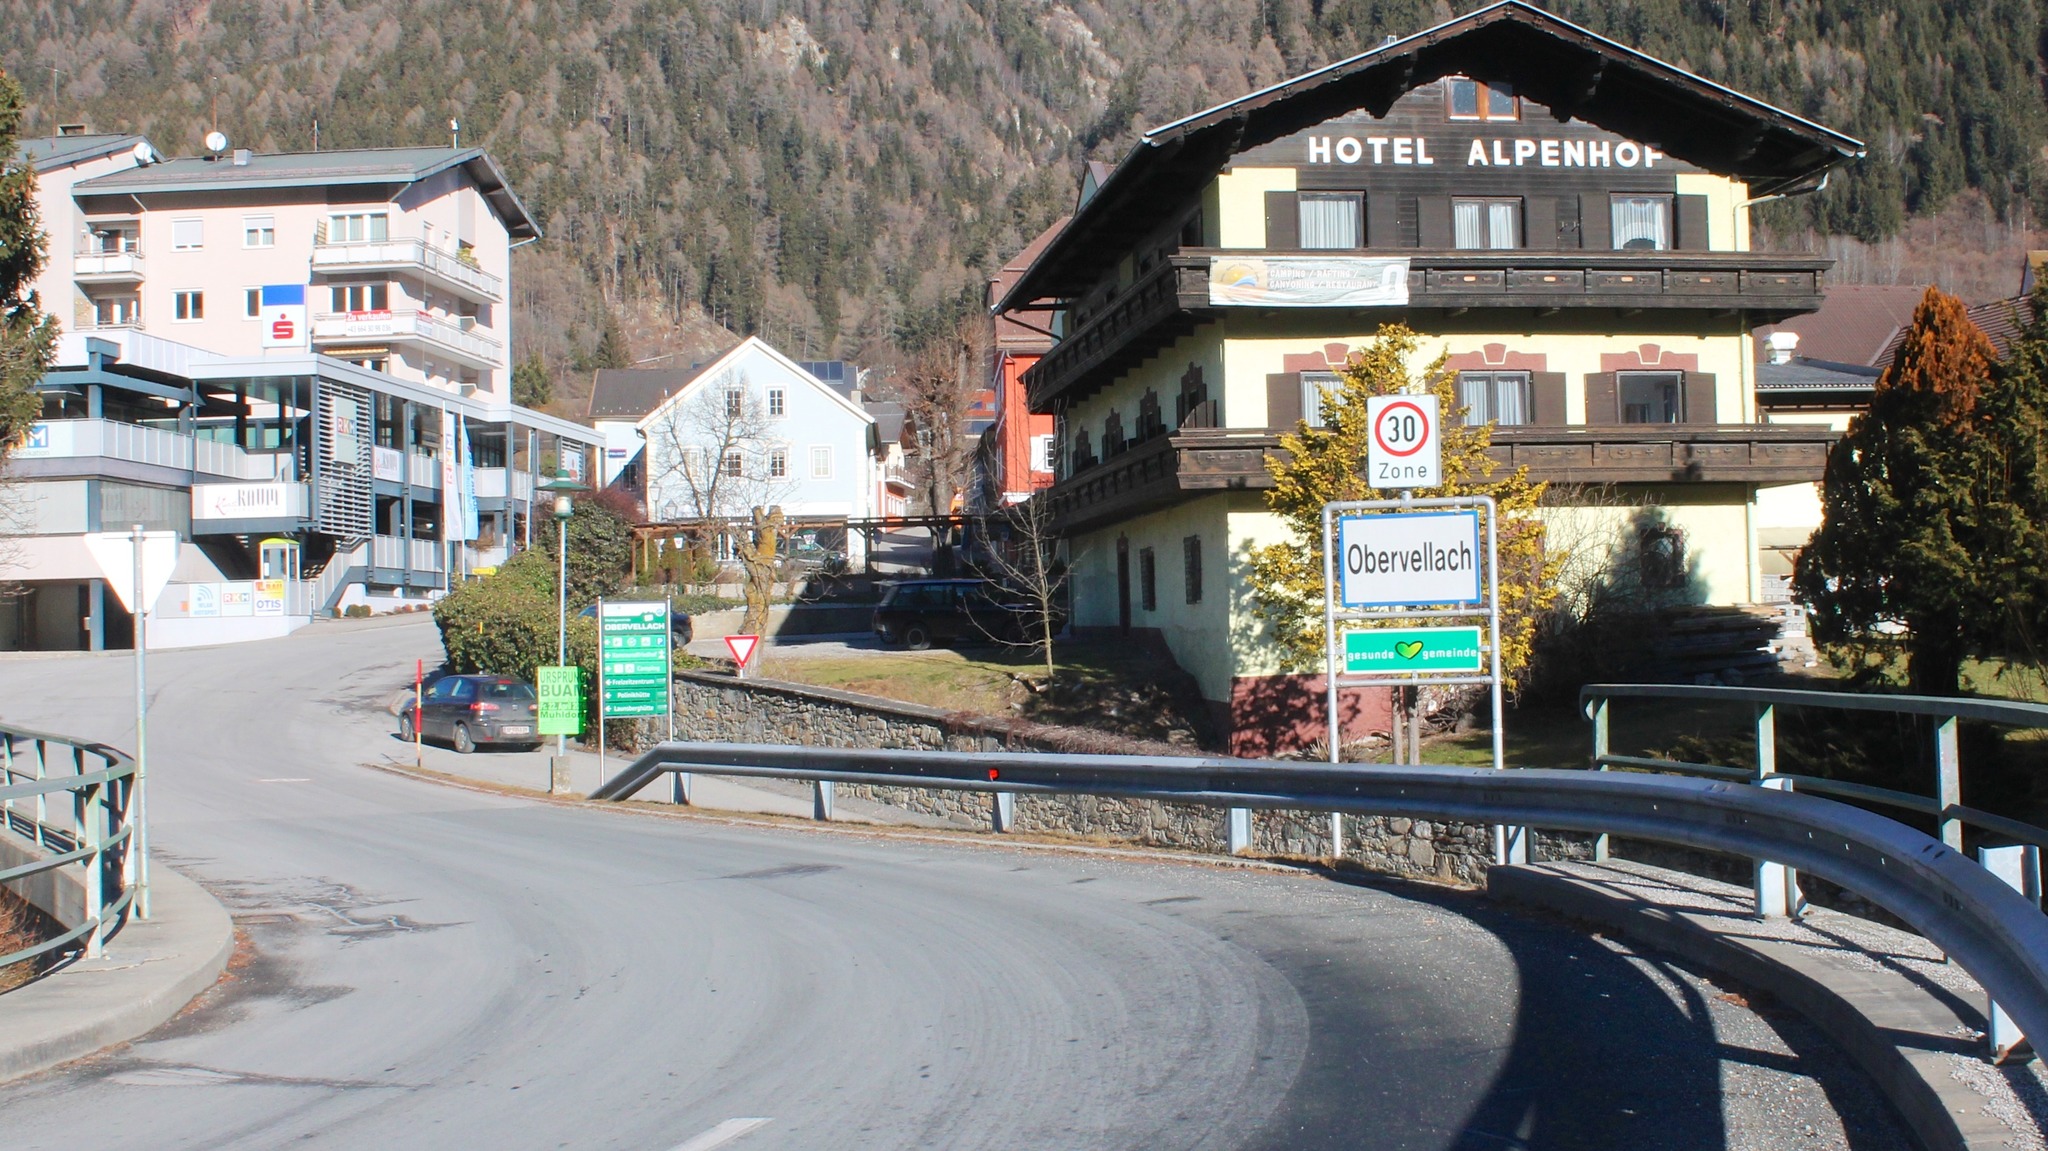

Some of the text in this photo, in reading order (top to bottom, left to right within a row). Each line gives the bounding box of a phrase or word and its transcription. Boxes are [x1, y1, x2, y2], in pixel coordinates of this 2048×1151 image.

[1308, 136, 1663, 168] HOTEL ALPENHOF
[1269, 269, 1305, 278] CAMPING
[1316, 269, 1350, 278] RAFTING
[1269, 280, 1315, 289] CANYONING
[1325, 280, 1377, 289] RESTAURANT
[357, 312, 391, 321] verkaufen
[1387, 415, 1415, 442] 30
[1378, 462, 1428, 479] Zone
[1347, 540, 1472, 574] Obervellach
[223, 593, 250, 603] RKM
[256, 599, 281, 609] OTIS
[604, 622, 666, 630] OBERVELLACH
[1347, 647, 1477, 662] gesunde gemeinde
[540, 671, 586, 684] URSPRUNG
